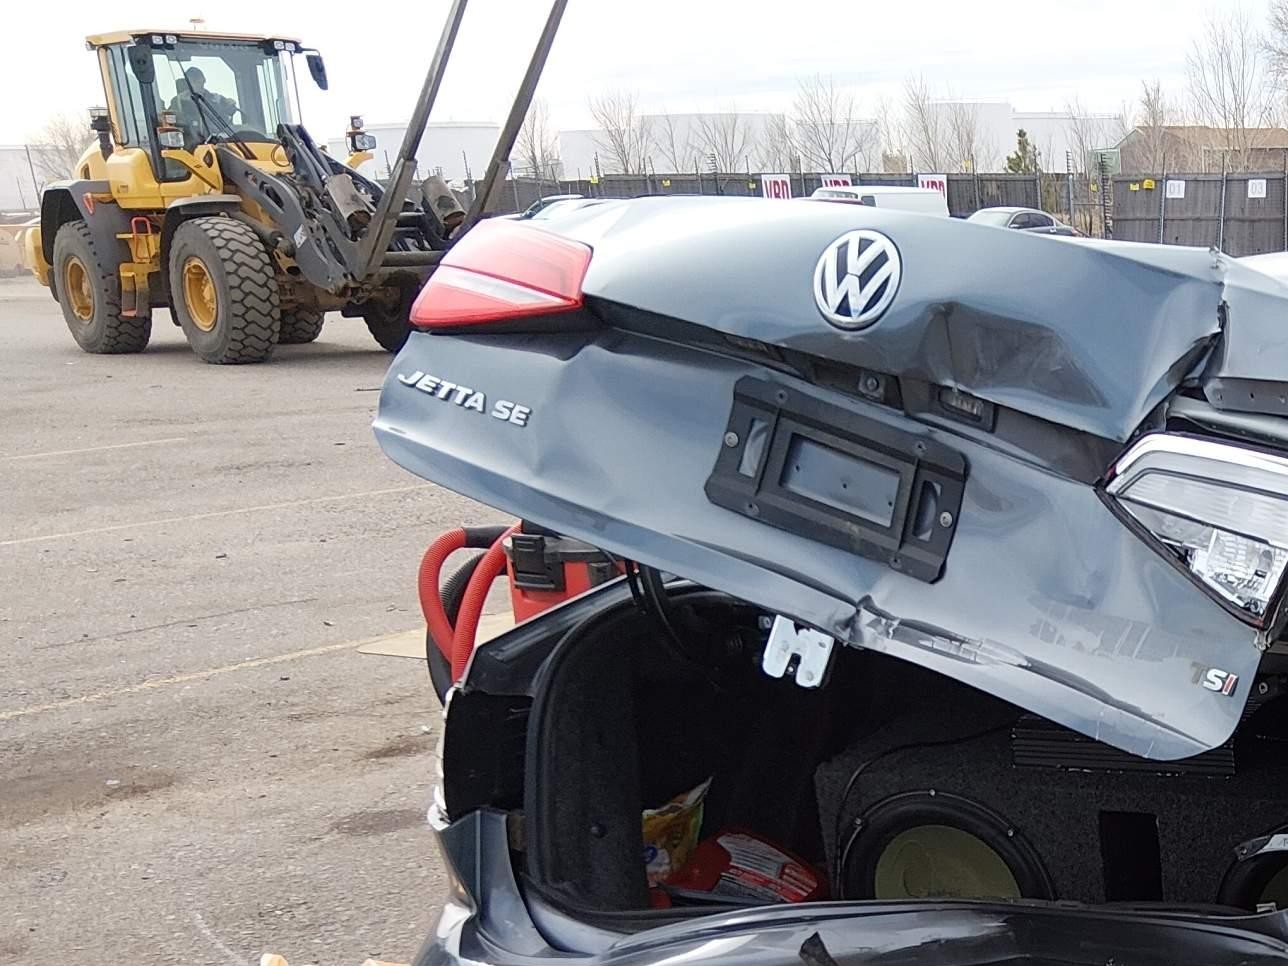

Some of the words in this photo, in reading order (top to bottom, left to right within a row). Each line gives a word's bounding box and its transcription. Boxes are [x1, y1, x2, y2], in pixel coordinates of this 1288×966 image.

[1168, 182, 1182, 196] 01
[1250, 182, 1263, 196] 03
[818, 232, 898, 324] VW
[396, 370, 486, 413] JETTA
[492, 399, 532, 427] SE
